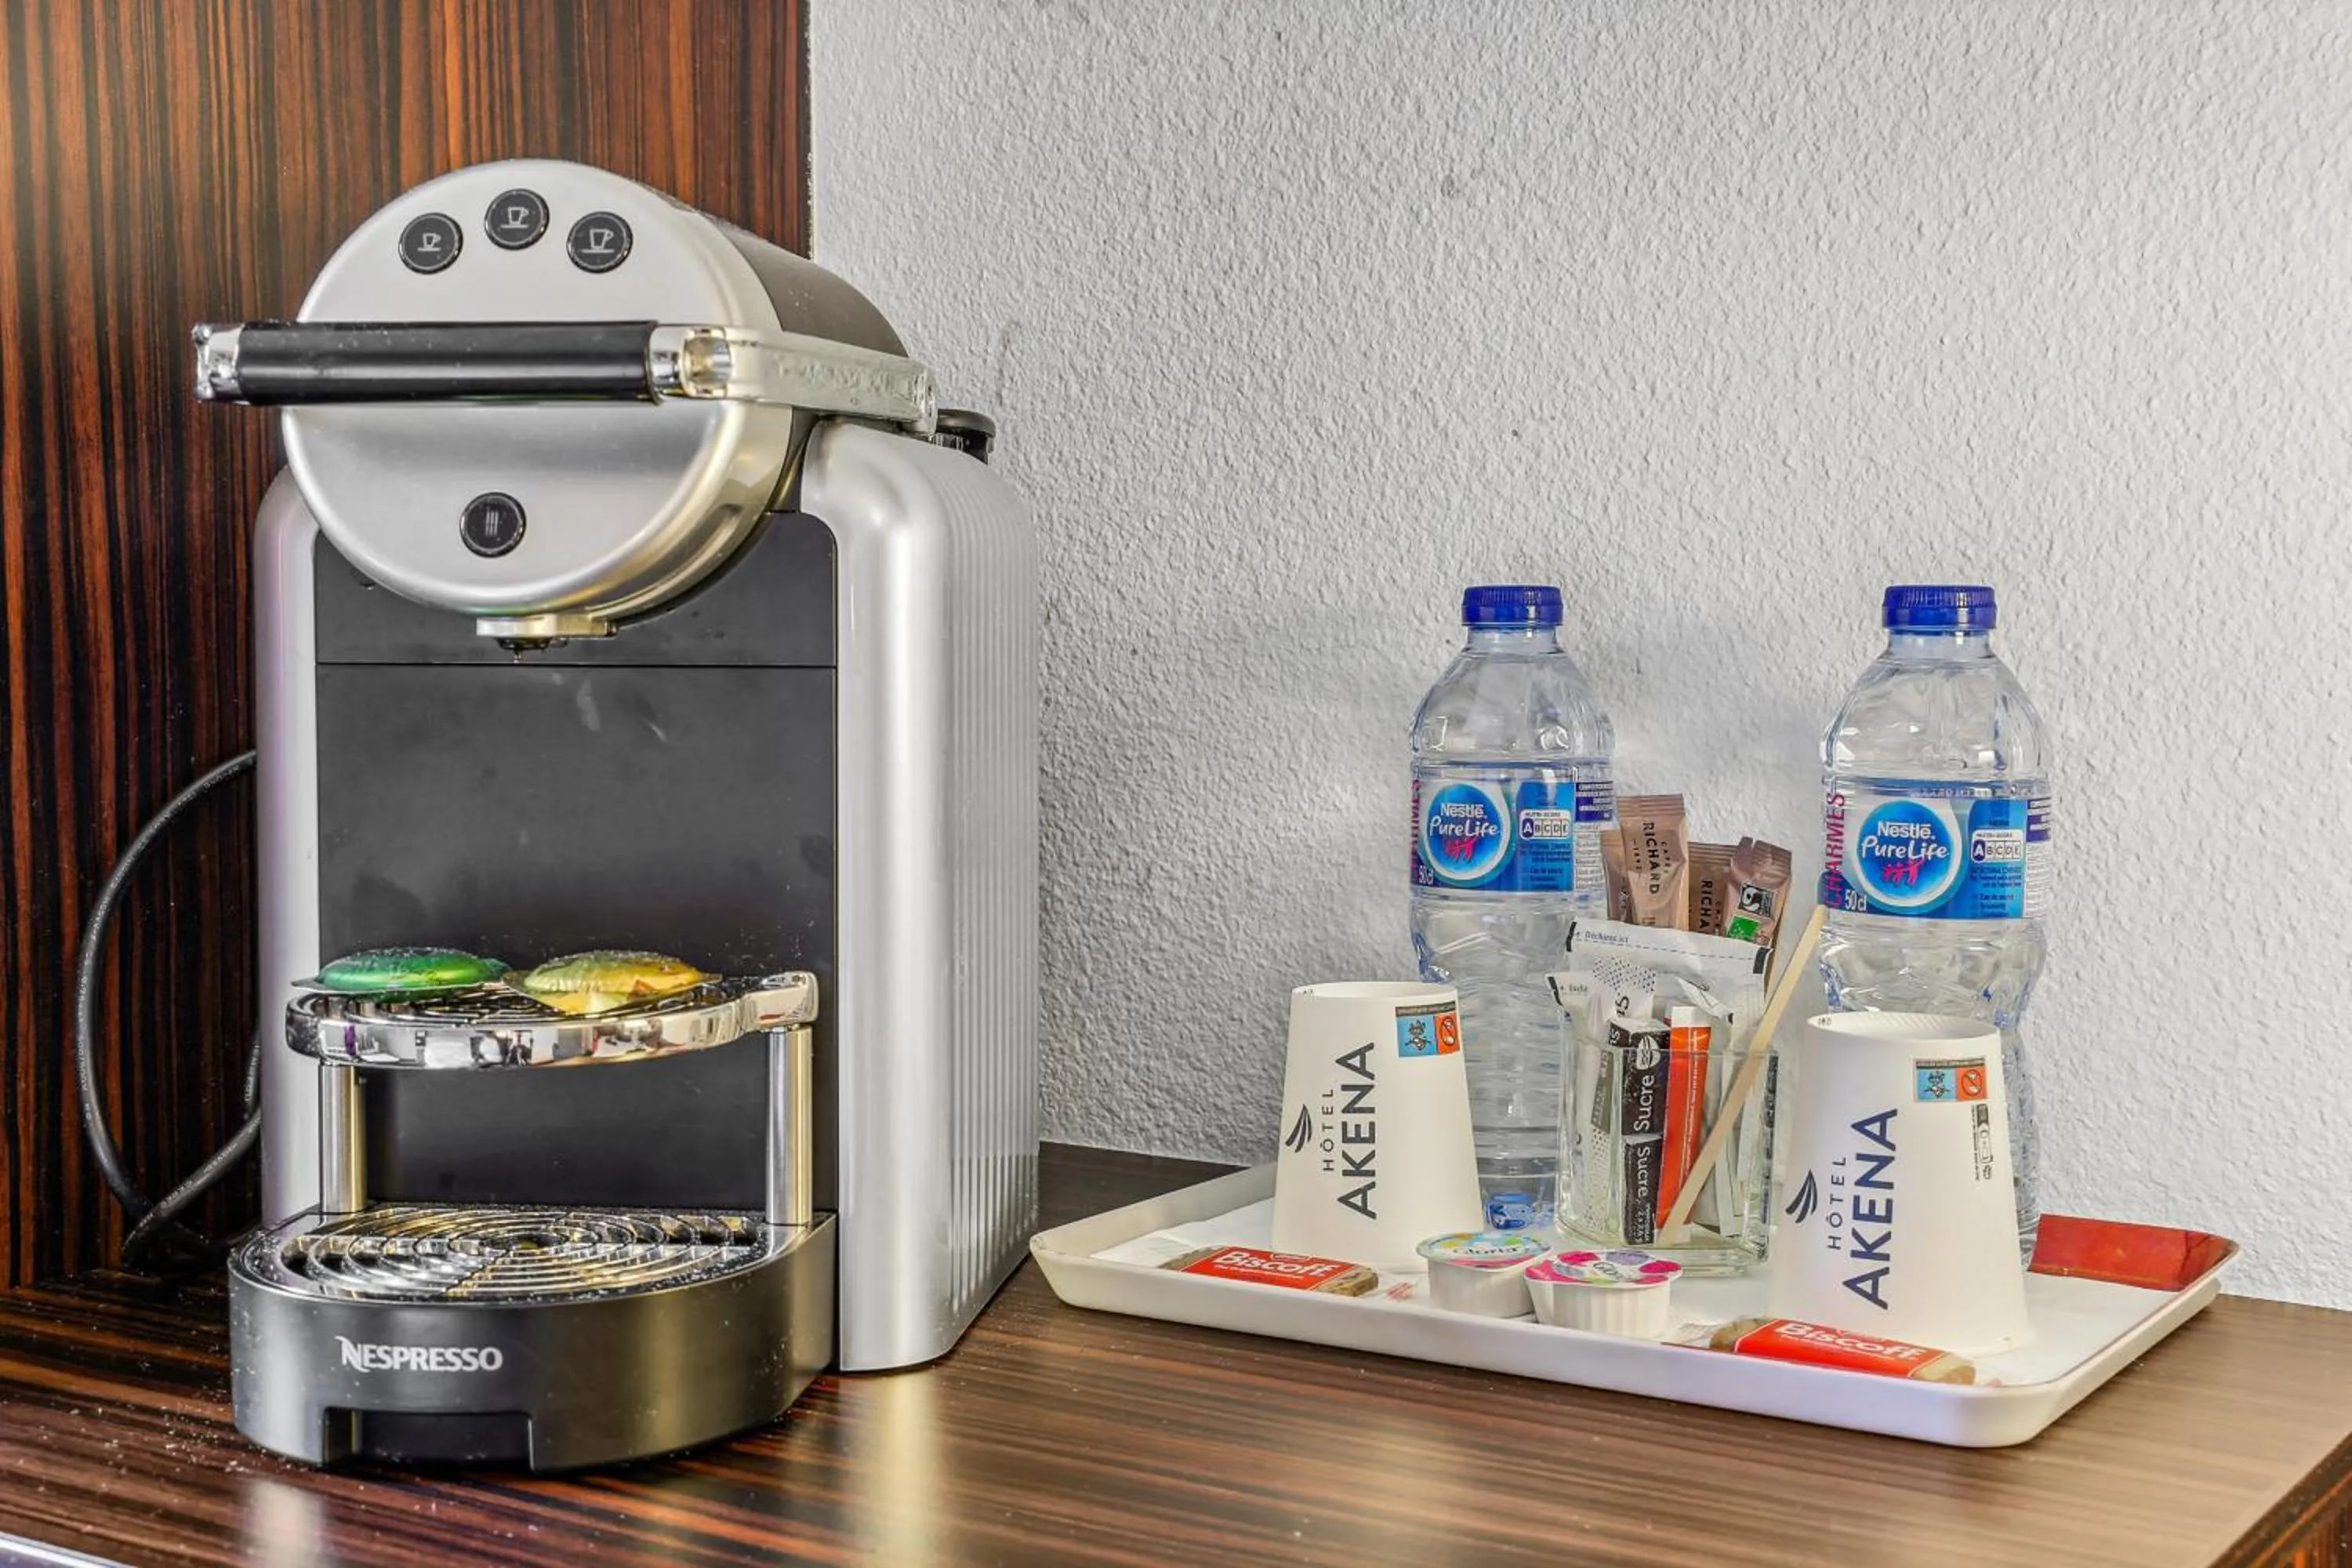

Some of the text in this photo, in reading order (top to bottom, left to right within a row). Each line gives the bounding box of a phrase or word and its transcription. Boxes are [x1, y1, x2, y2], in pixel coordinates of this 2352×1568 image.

[1642, 822, 1660, 895] RICHARD
[1824, 793, 1845, 908] CHARMES
[1699, 880, 1713, 932] RICHA
[1319, 1089, 1335, 1172] HÔTEL
[1335, 1042, 1377, 1220] AKENA
[1633, 1074, 1655, 1131] Sucre
[1636, 1146, 1650, 1198] Sucre
[1825, 1156, 1847, 1250] HÔTEL
[1842, 1108, 1898, 1310] AKENA
[1214, 1250, 1340, 1277] Biscoff
[1775, 1323, 1927, 1361] Biscoff
